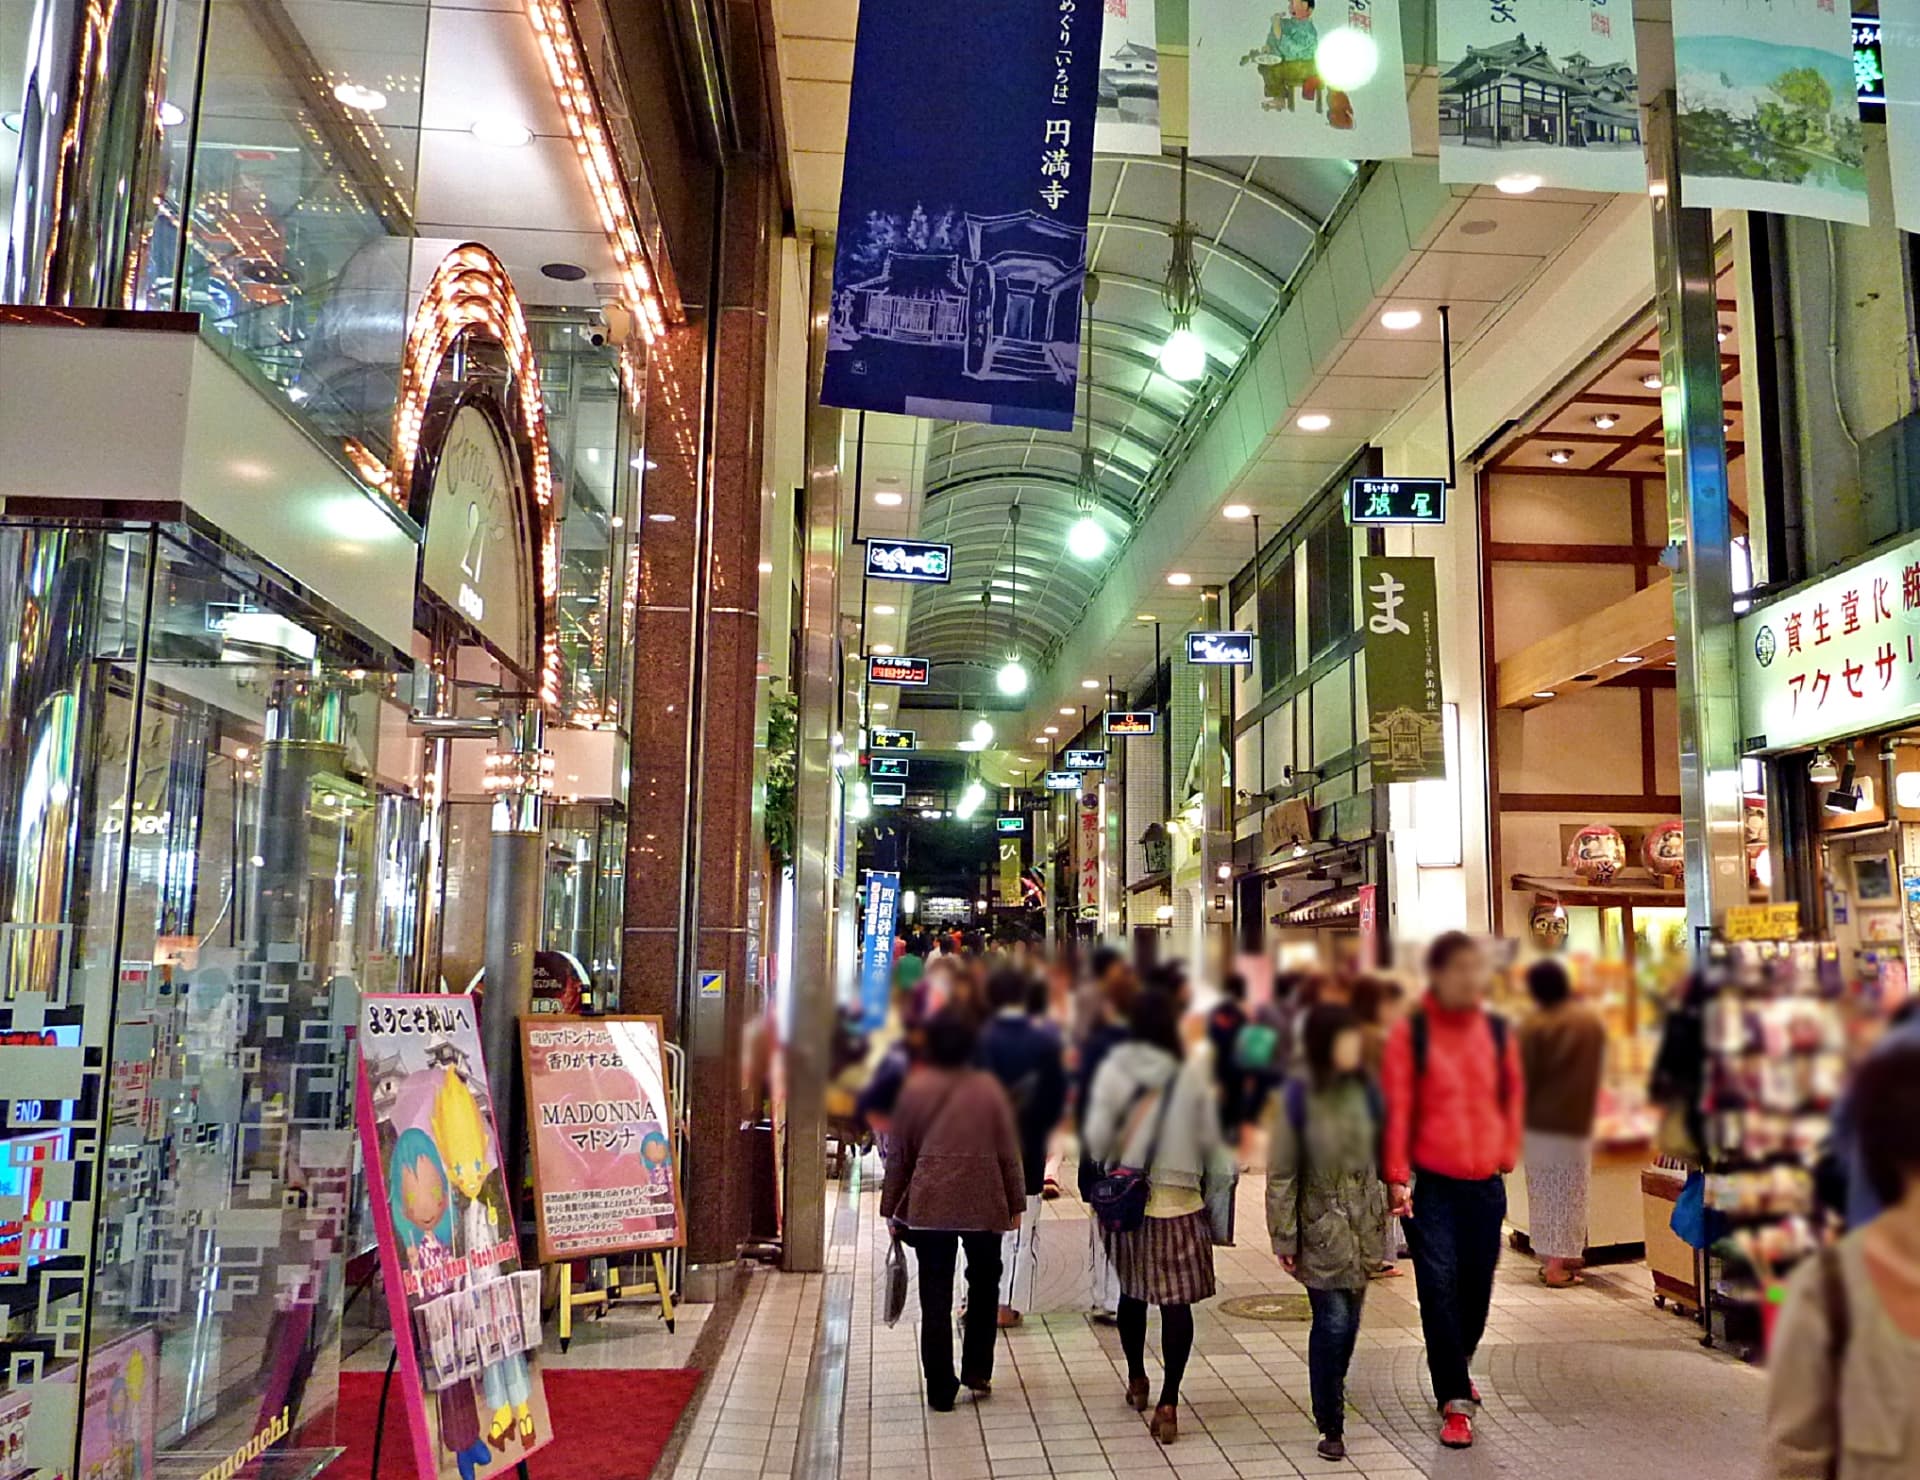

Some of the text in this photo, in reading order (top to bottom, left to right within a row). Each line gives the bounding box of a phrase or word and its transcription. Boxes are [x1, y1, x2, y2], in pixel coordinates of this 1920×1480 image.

[1039, 119, 1072, 210] 円満寺
[1369, 572, 1410, 635] ま
[872, 667, 925, 681] 四国サンゴ
[999, 844, 1017, 861] ひ
[369, 1005, 470, 1034] ようこそ松山へ
[542, 1102, 657, 1125] MADONNA
[571, 1128, 635, 1150] マドンナ
